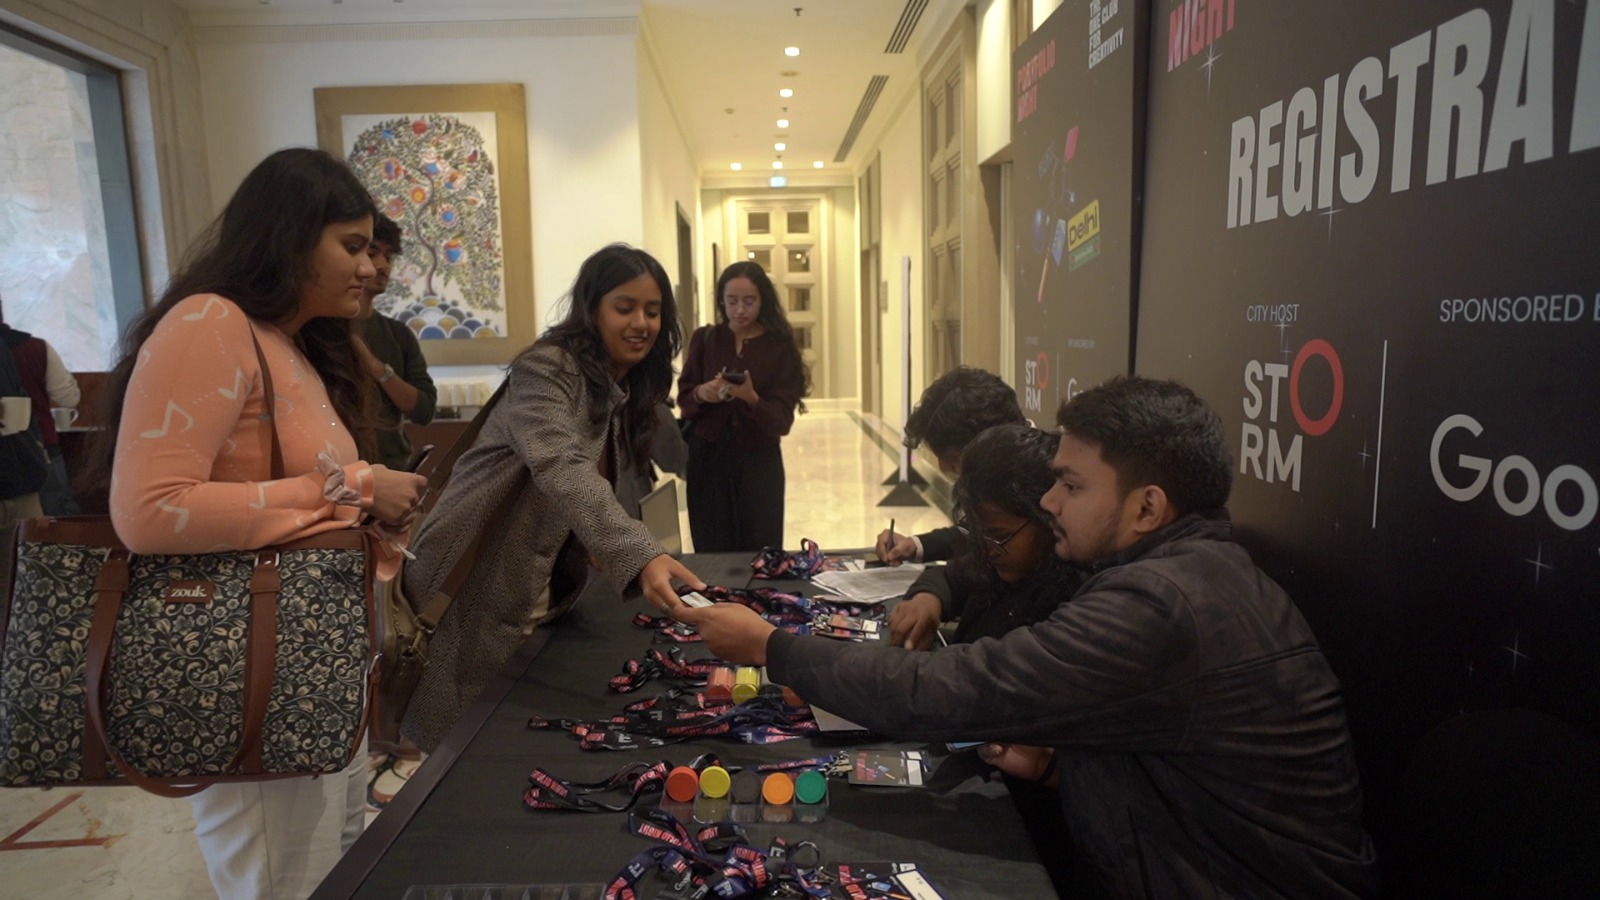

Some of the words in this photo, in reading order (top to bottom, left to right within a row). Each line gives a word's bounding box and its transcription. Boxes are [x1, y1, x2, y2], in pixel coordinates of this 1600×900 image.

[1226, 0, 1600, 229] REGISTRA
[1069, 205, 1098, 246] Delhi
[1246, 304, 1269, 322] CITY
[1270, 303, 1300, 322] HOST
[1439, 294, 1585, 322] SPONSORED
